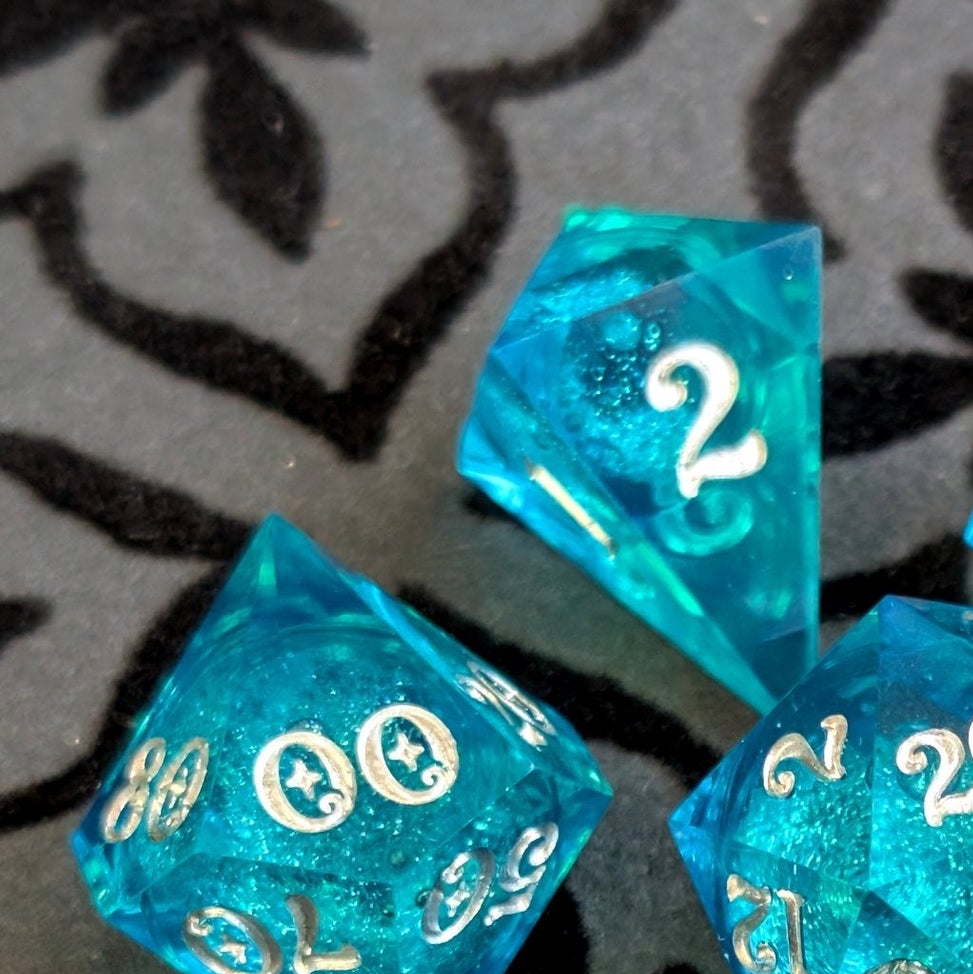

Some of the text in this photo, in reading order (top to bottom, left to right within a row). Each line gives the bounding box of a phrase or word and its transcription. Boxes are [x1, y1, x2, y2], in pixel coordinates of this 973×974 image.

[645, 341, 768, 499] 2
[101, 736, 210, 843] 80
[252, 703, 460, 834] 00
[763, 714, 848, 797] 2
[421, 823, 560, 945] 50
